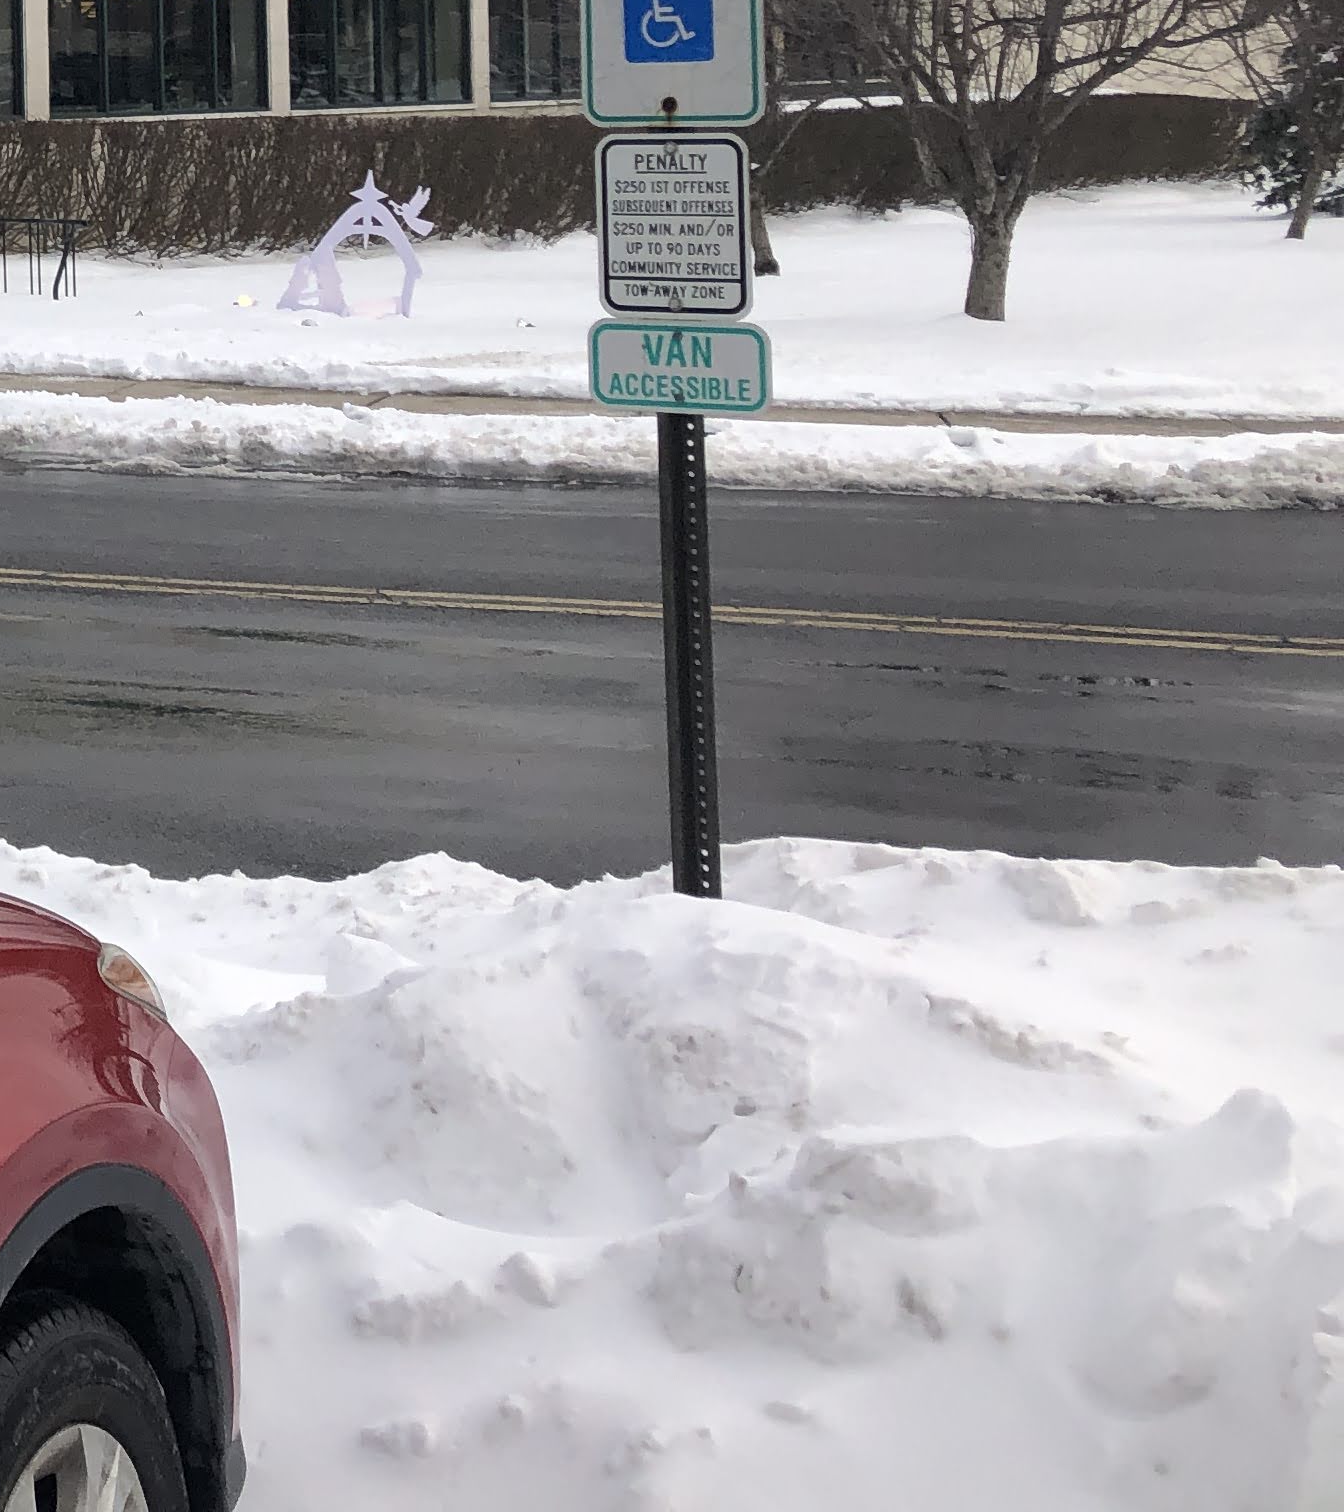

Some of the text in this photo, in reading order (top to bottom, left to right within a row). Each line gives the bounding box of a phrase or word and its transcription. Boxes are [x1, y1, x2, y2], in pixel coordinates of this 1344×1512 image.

[634, 154, 708, 171] PENALTY
[614, 180, 731, 195] $250 1ST OFFENSE
[612, 200, 734, 214] SUBSEQUENT OFFENSES
[613, 219, 735, 237] $250 MIN. AND/OR
[626, 242, 721, 257] UP TO 90 DAYS
[611, 261, 739, 276] COMMUNITY SERVICE
[624, 283, 725, 300] TOW-AWAY ZONE
[642, 333, 712, 368] VAN
[609, 372, 753, 402] ACCESSIBLE
